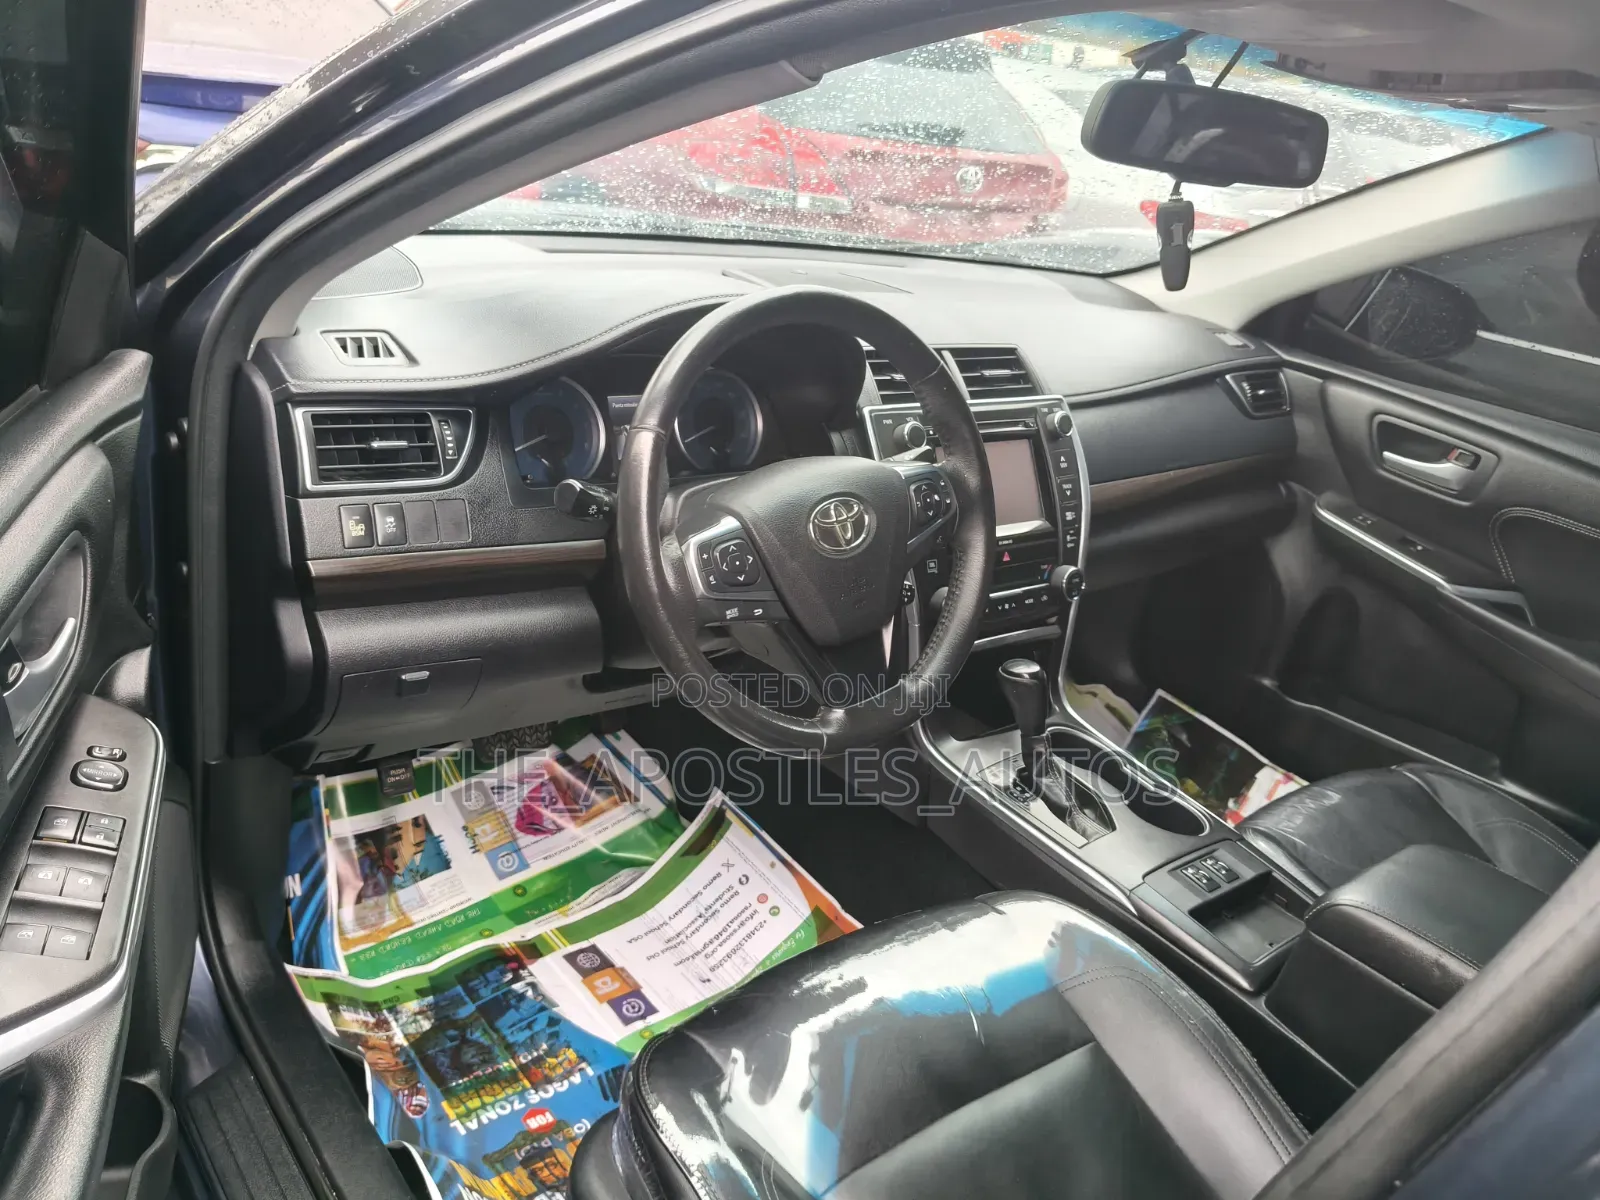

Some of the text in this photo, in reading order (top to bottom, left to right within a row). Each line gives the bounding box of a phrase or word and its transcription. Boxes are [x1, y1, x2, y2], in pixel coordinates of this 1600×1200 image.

[700, 871, 722, 892] Remo
[666, 889, 703, 922] Secondary
[413, 923, 443, 940] AHEAD
[642, 919, 668, 936] School
[645, 889, 740, 962] Remo Secondary School Old
[663, 912, 704, 945] Association
[523, 1061, 595, 1105] LAGOS
[449, 1094, 526, 1136] ZONAL
[526, 1113, 555, 1130] FOR
